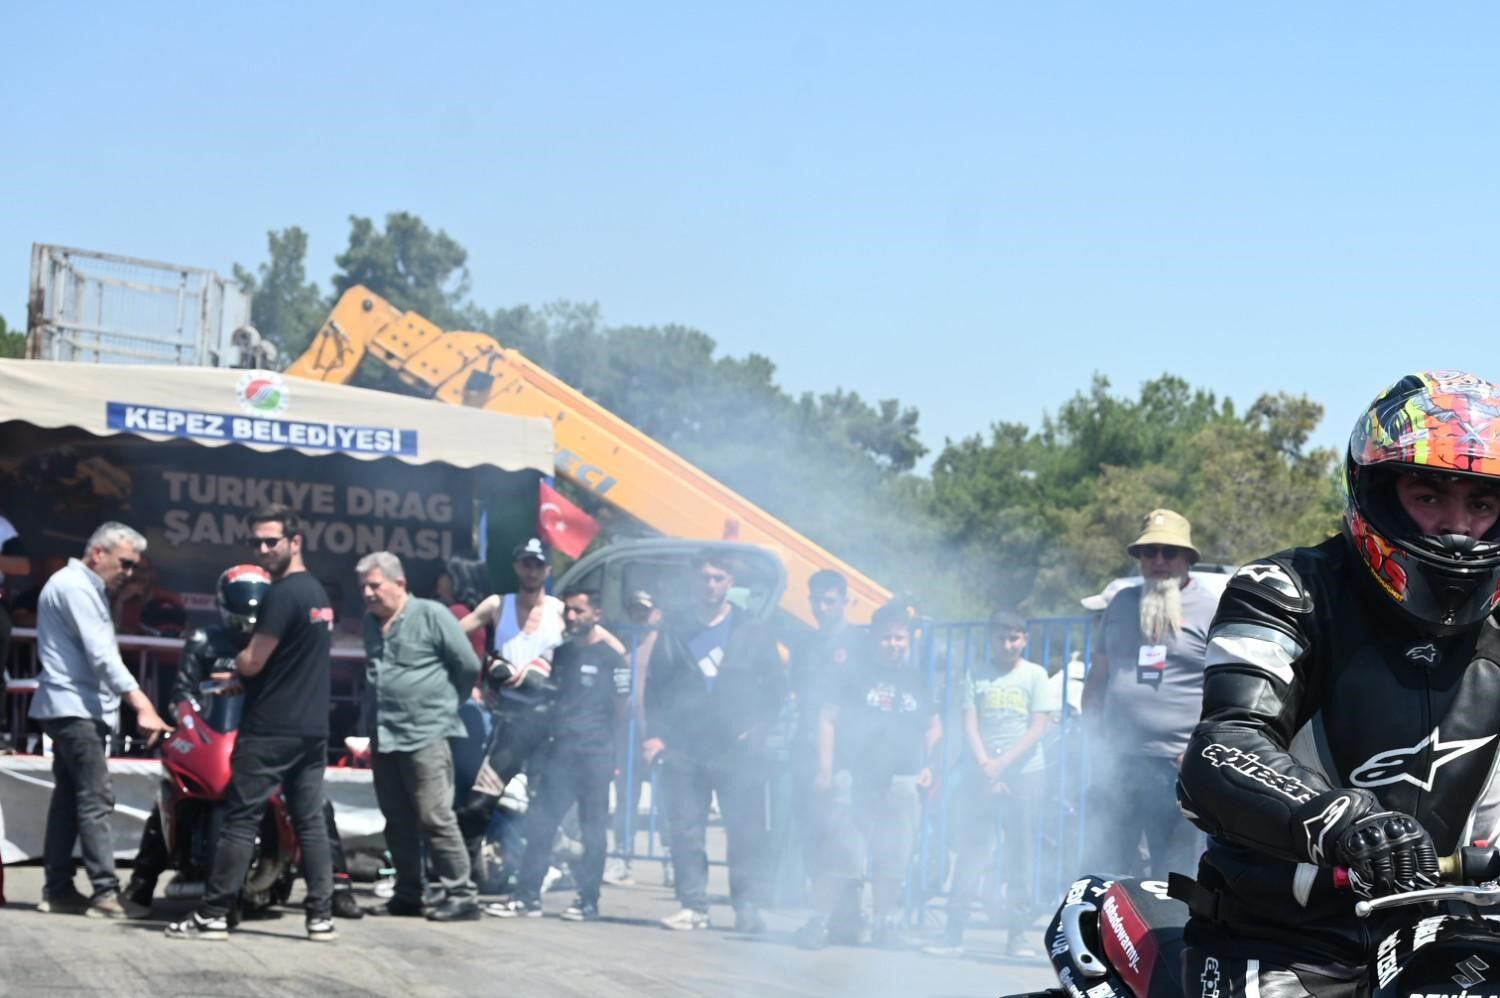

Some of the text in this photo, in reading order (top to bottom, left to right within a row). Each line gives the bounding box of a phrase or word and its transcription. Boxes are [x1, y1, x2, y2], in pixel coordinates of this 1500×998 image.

[125, 406, 402, 452] KEPEZ BELEDİYESİ
[345, 486, 452, 523] DRAG
[163, 509, 451, 563] ŞAMYONASI
